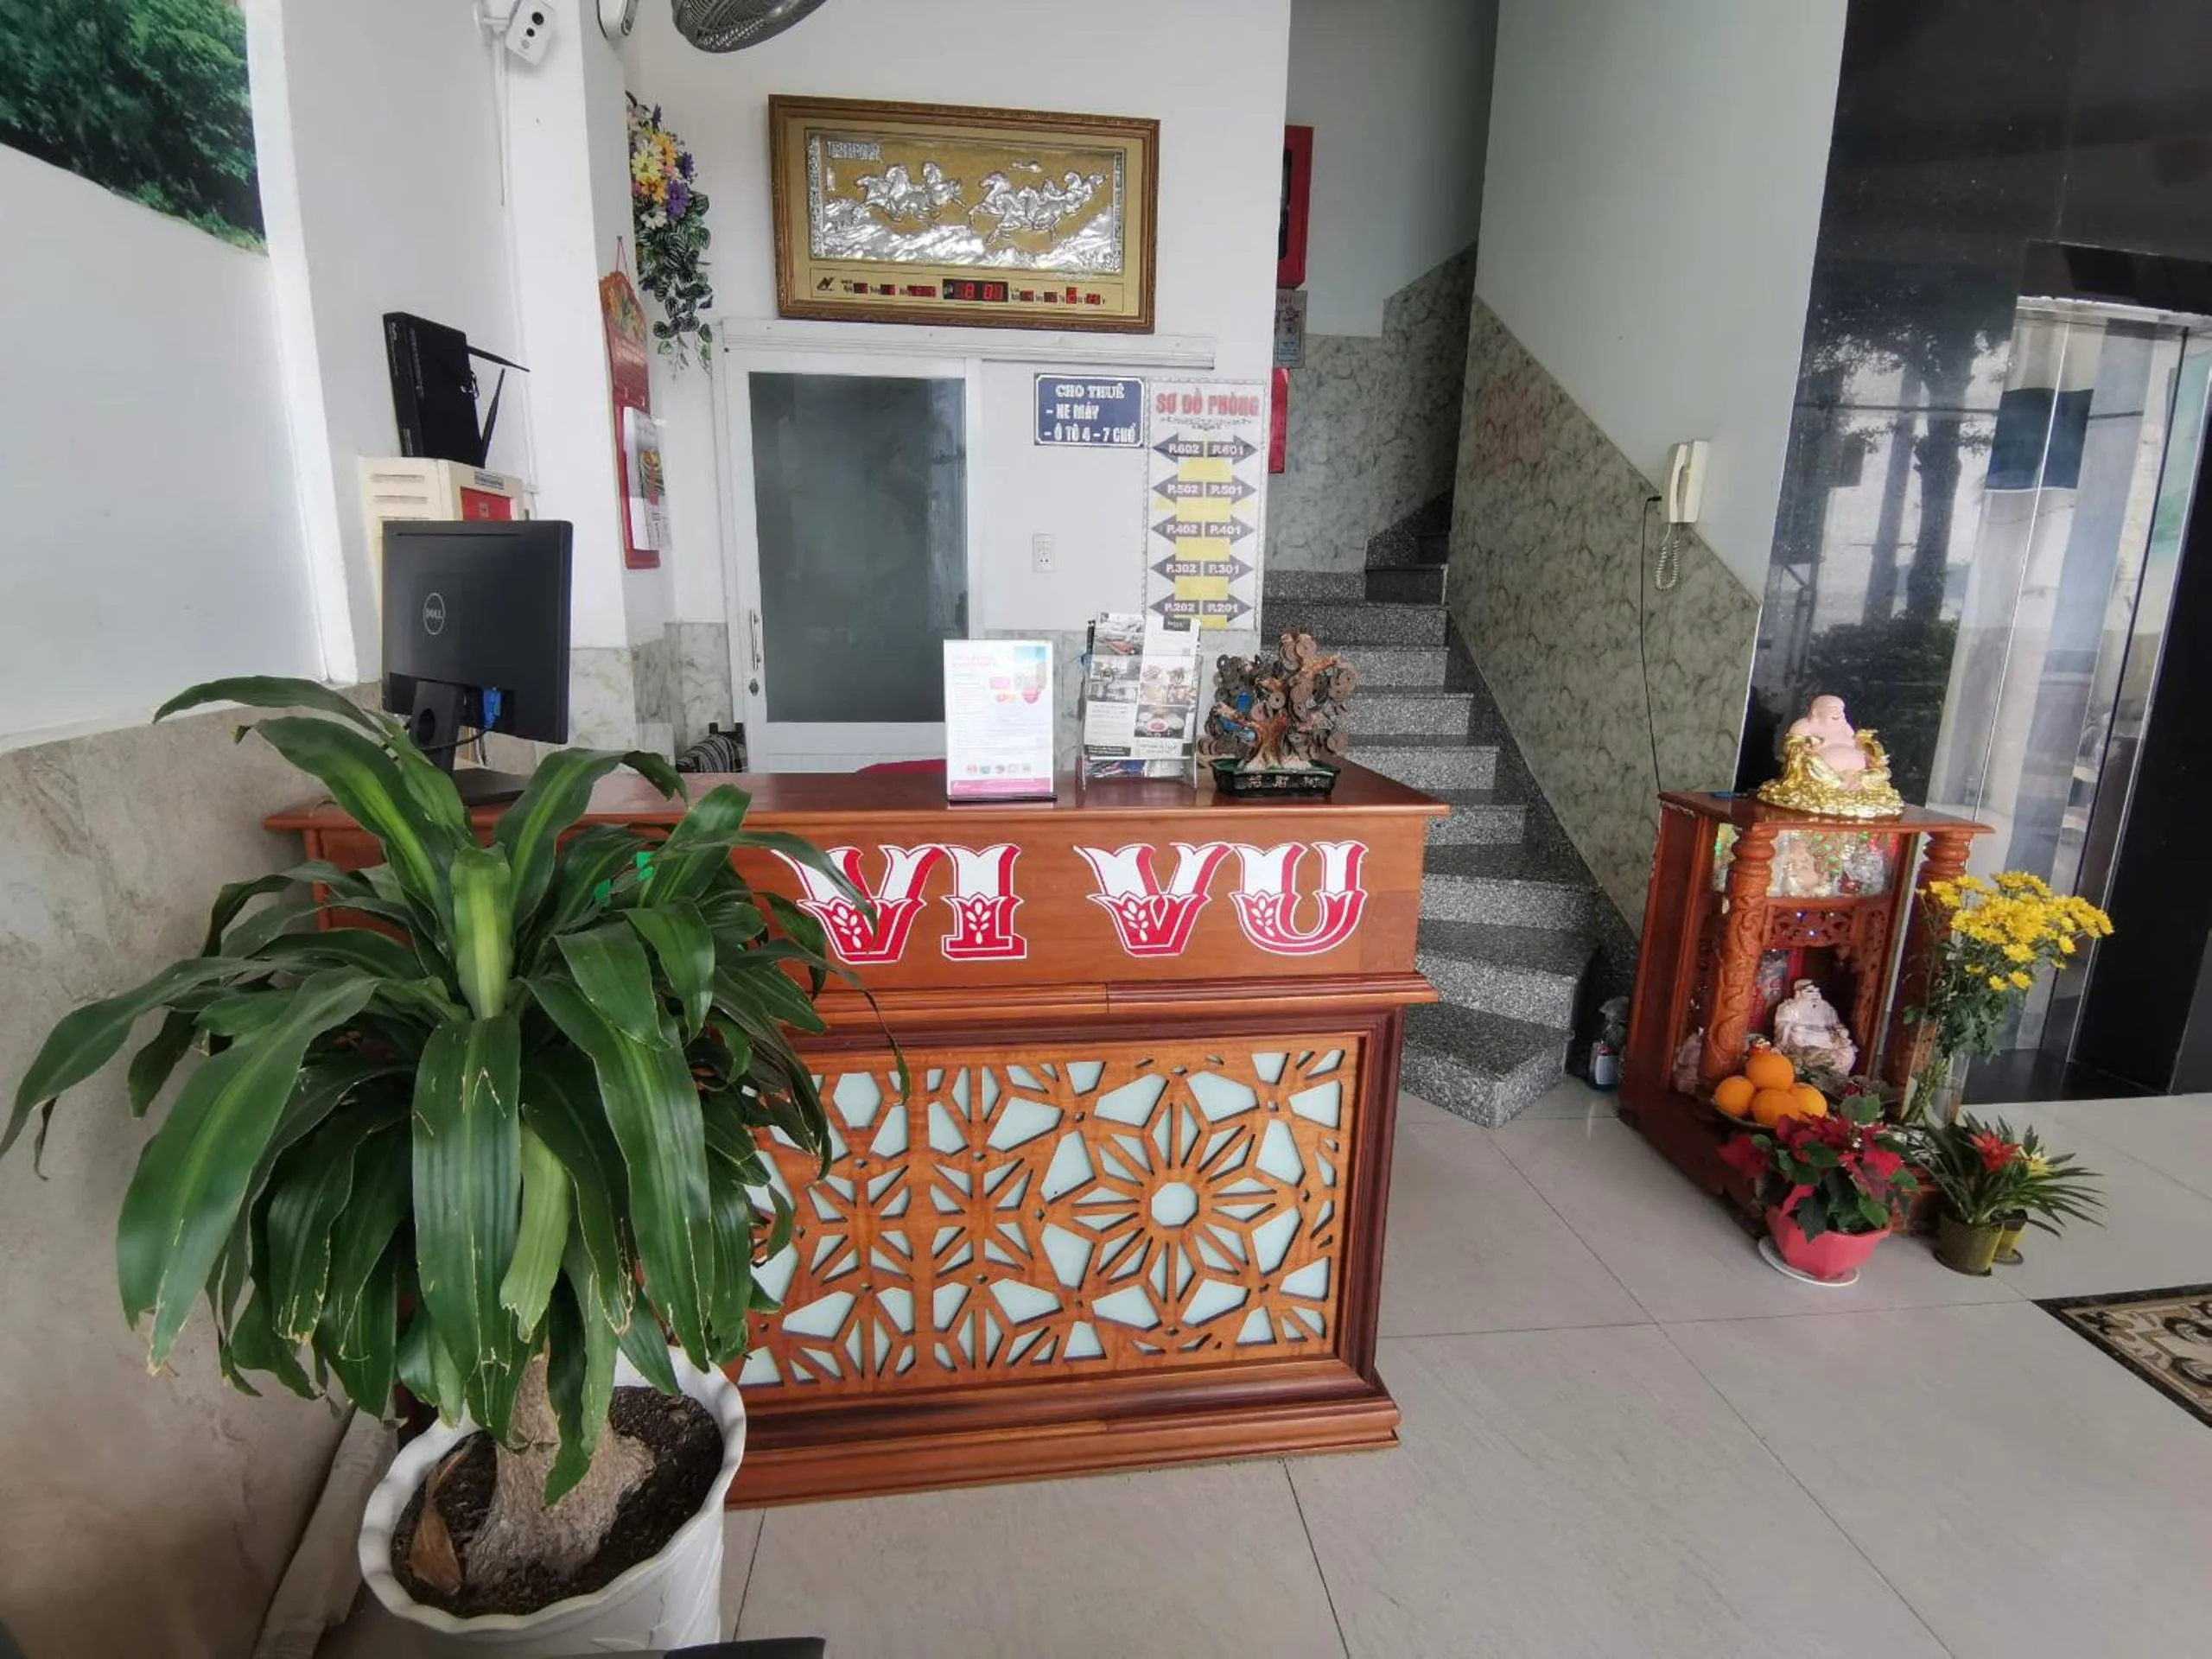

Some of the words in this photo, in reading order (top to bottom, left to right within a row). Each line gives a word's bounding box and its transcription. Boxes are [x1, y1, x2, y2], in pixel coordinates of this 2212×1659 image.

[1055, 384, 1084, 398] CHO
[1073, 401, 1099, 421] MÁY
[1208, 391, 1260, 416] PHÒNG
[1065, 423, 1080, 442] TÔ
[1103, 427, 1110, 442] 7
[425, 607, 444, 620] DELL
[771, 842, 1027, 965] VI
[1072, 840, 1370, 958] VU
